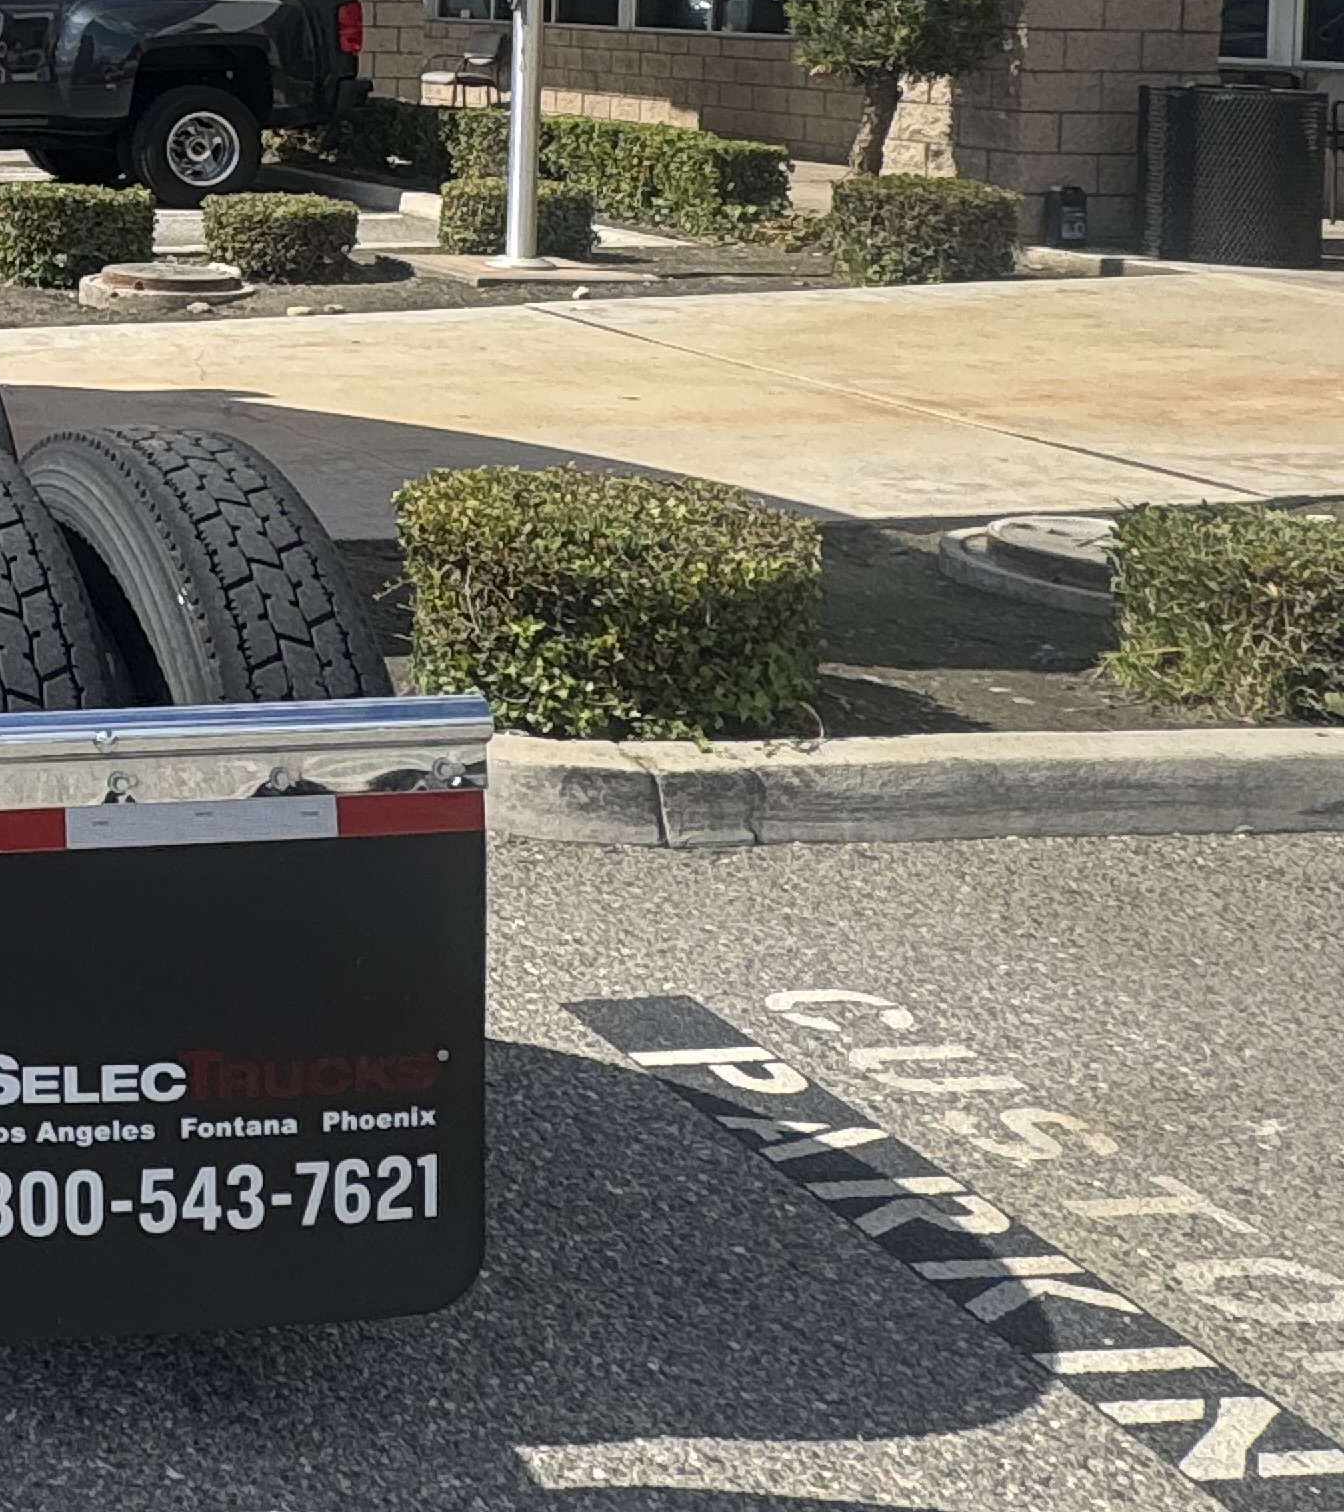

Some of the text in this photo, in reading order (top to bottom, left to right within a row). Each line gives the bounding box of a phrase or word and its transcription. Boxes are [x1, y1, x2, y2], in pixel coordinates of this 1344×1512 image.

[35, 1119, 156, 1148] Angeles
[180, 1115, 299, 1141] Fontana
[322, 1106, 438, 1134] Phoenix
[763, 988, 1344, 1374] CUSTO
